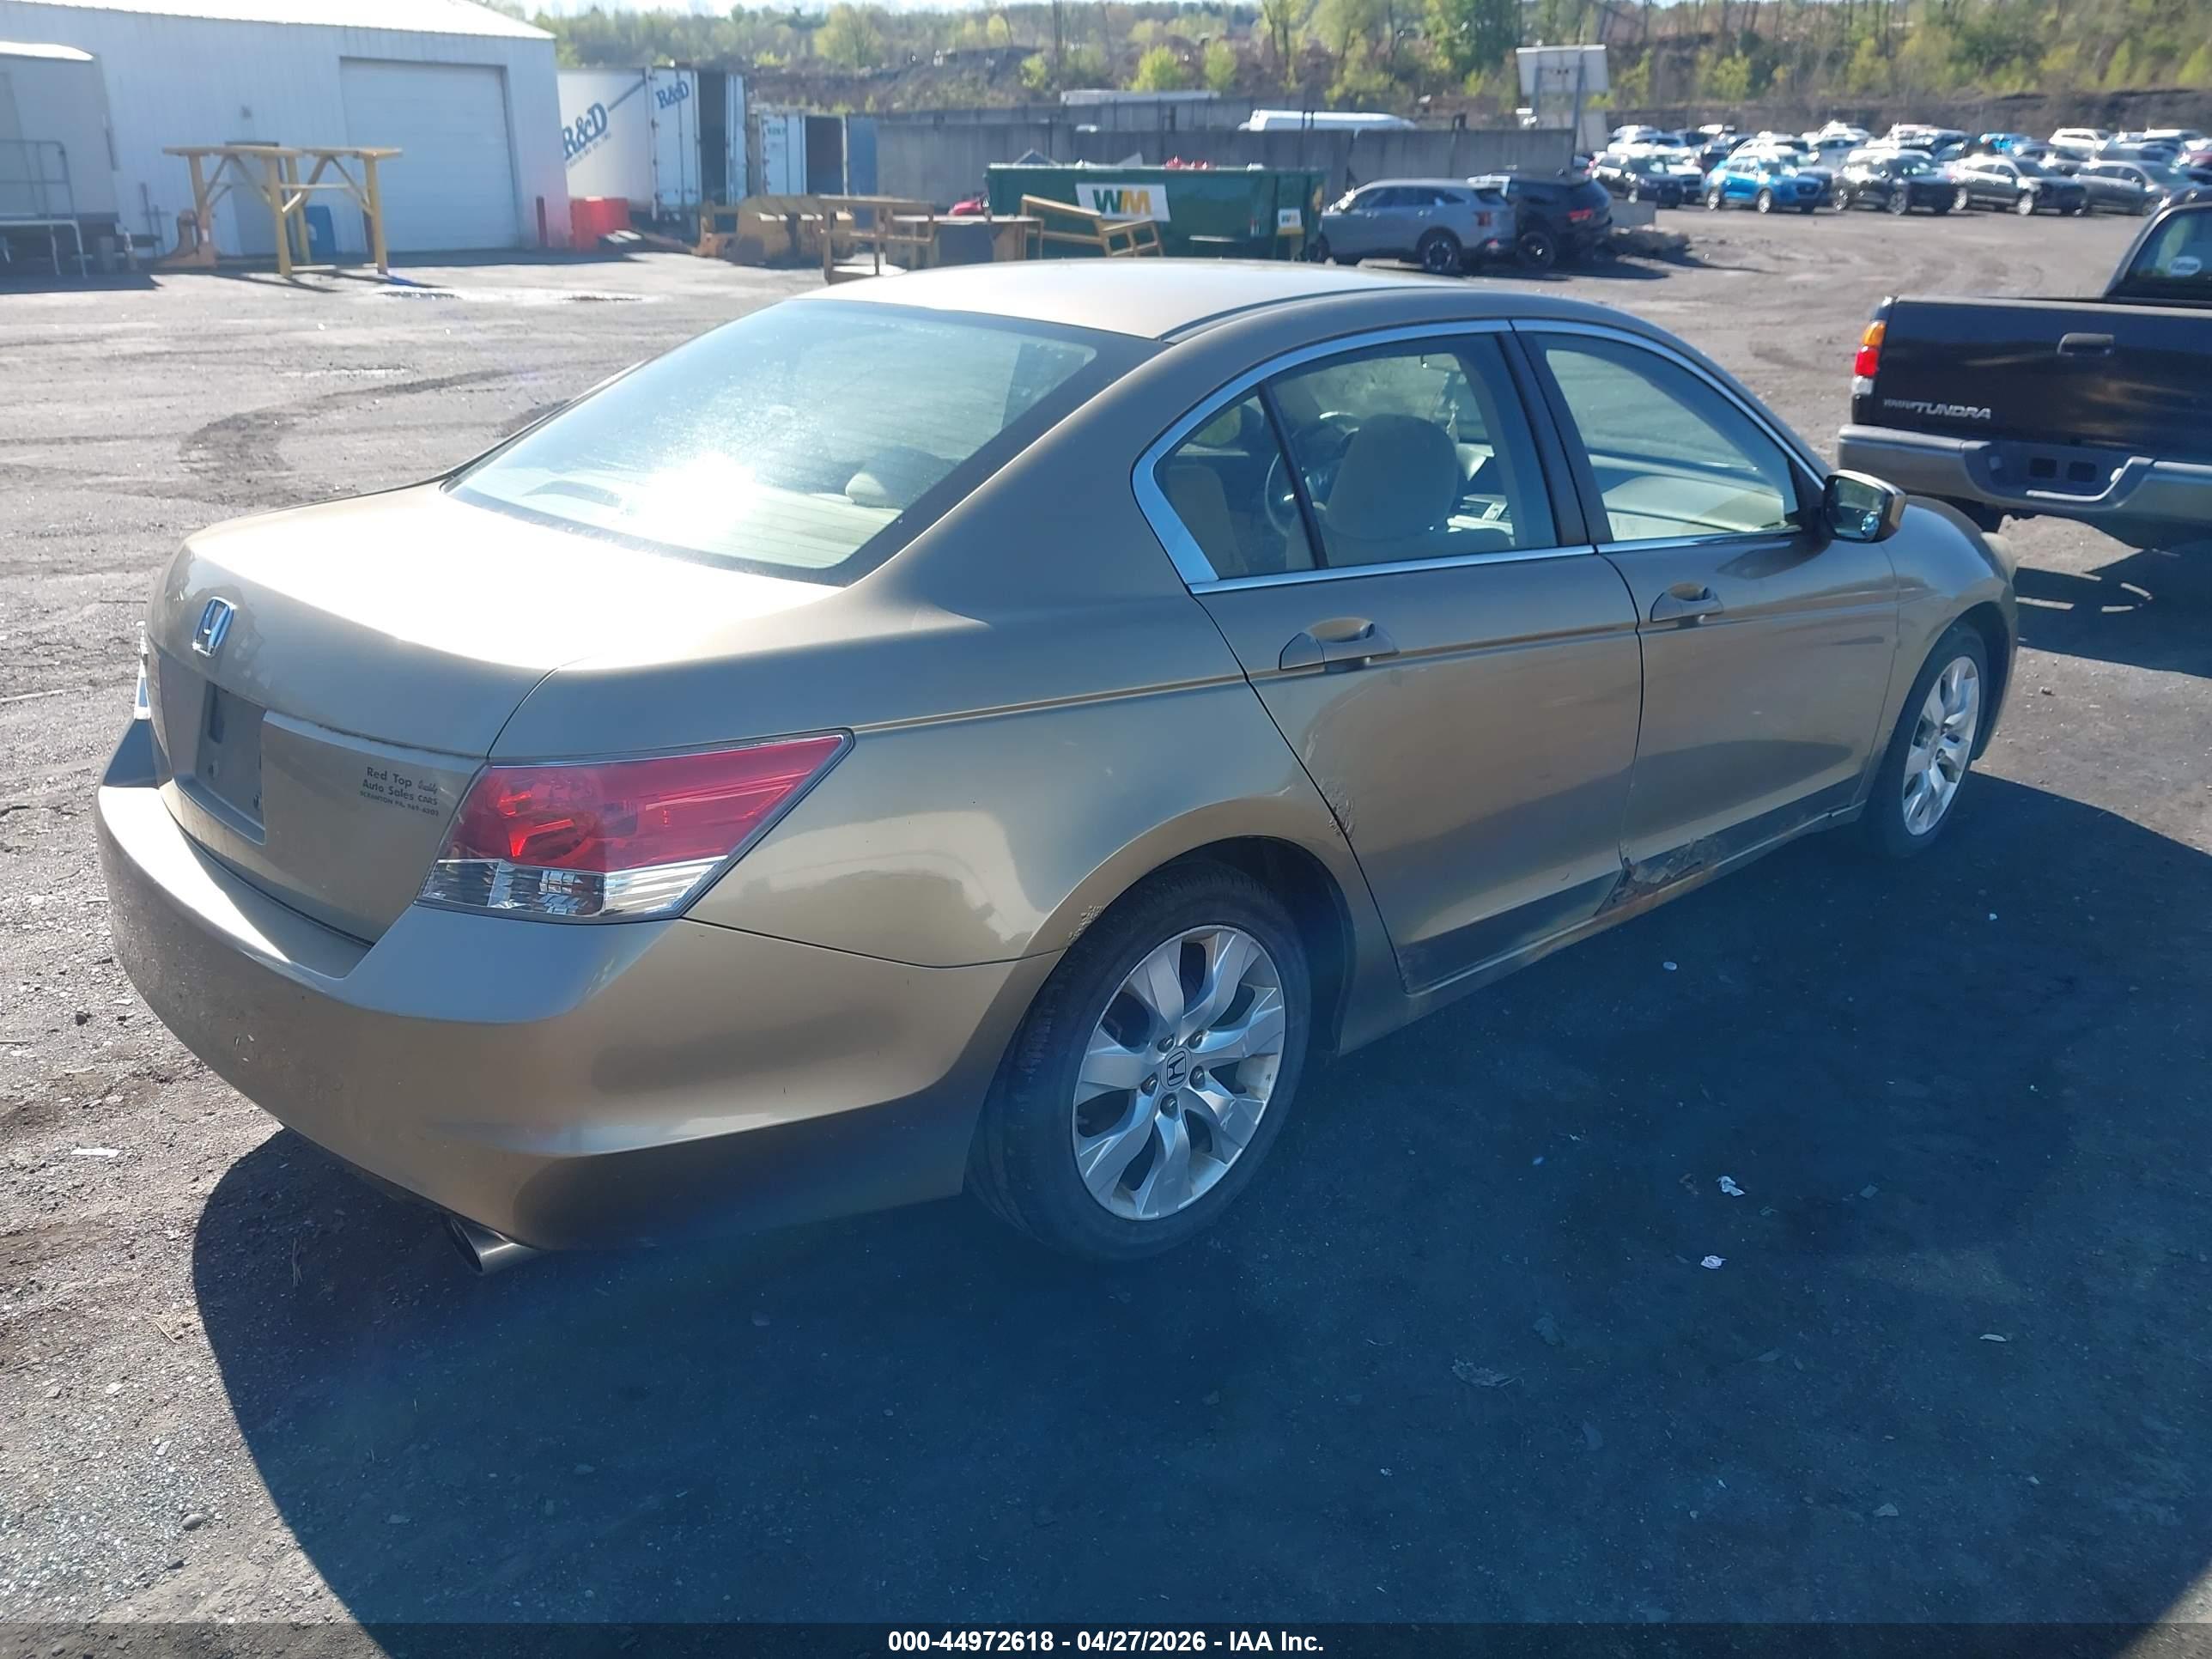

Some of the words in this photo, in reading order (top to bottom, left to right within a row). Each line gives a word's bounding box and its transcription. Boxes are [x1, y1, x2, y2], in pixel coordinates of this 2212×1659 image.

[656, 80, 690, 109] R&D
[562, 102, 608, 161] R&D
[1092, 189, 1151, 216] WM
[1911, 401, 1991, 419] TUNDRA
[362, 779, 385, 792] Auto
[387, 786, 414, 800] Sales
[367, 767, 387, 781] Red
[392, 773, 412, 788] Top
